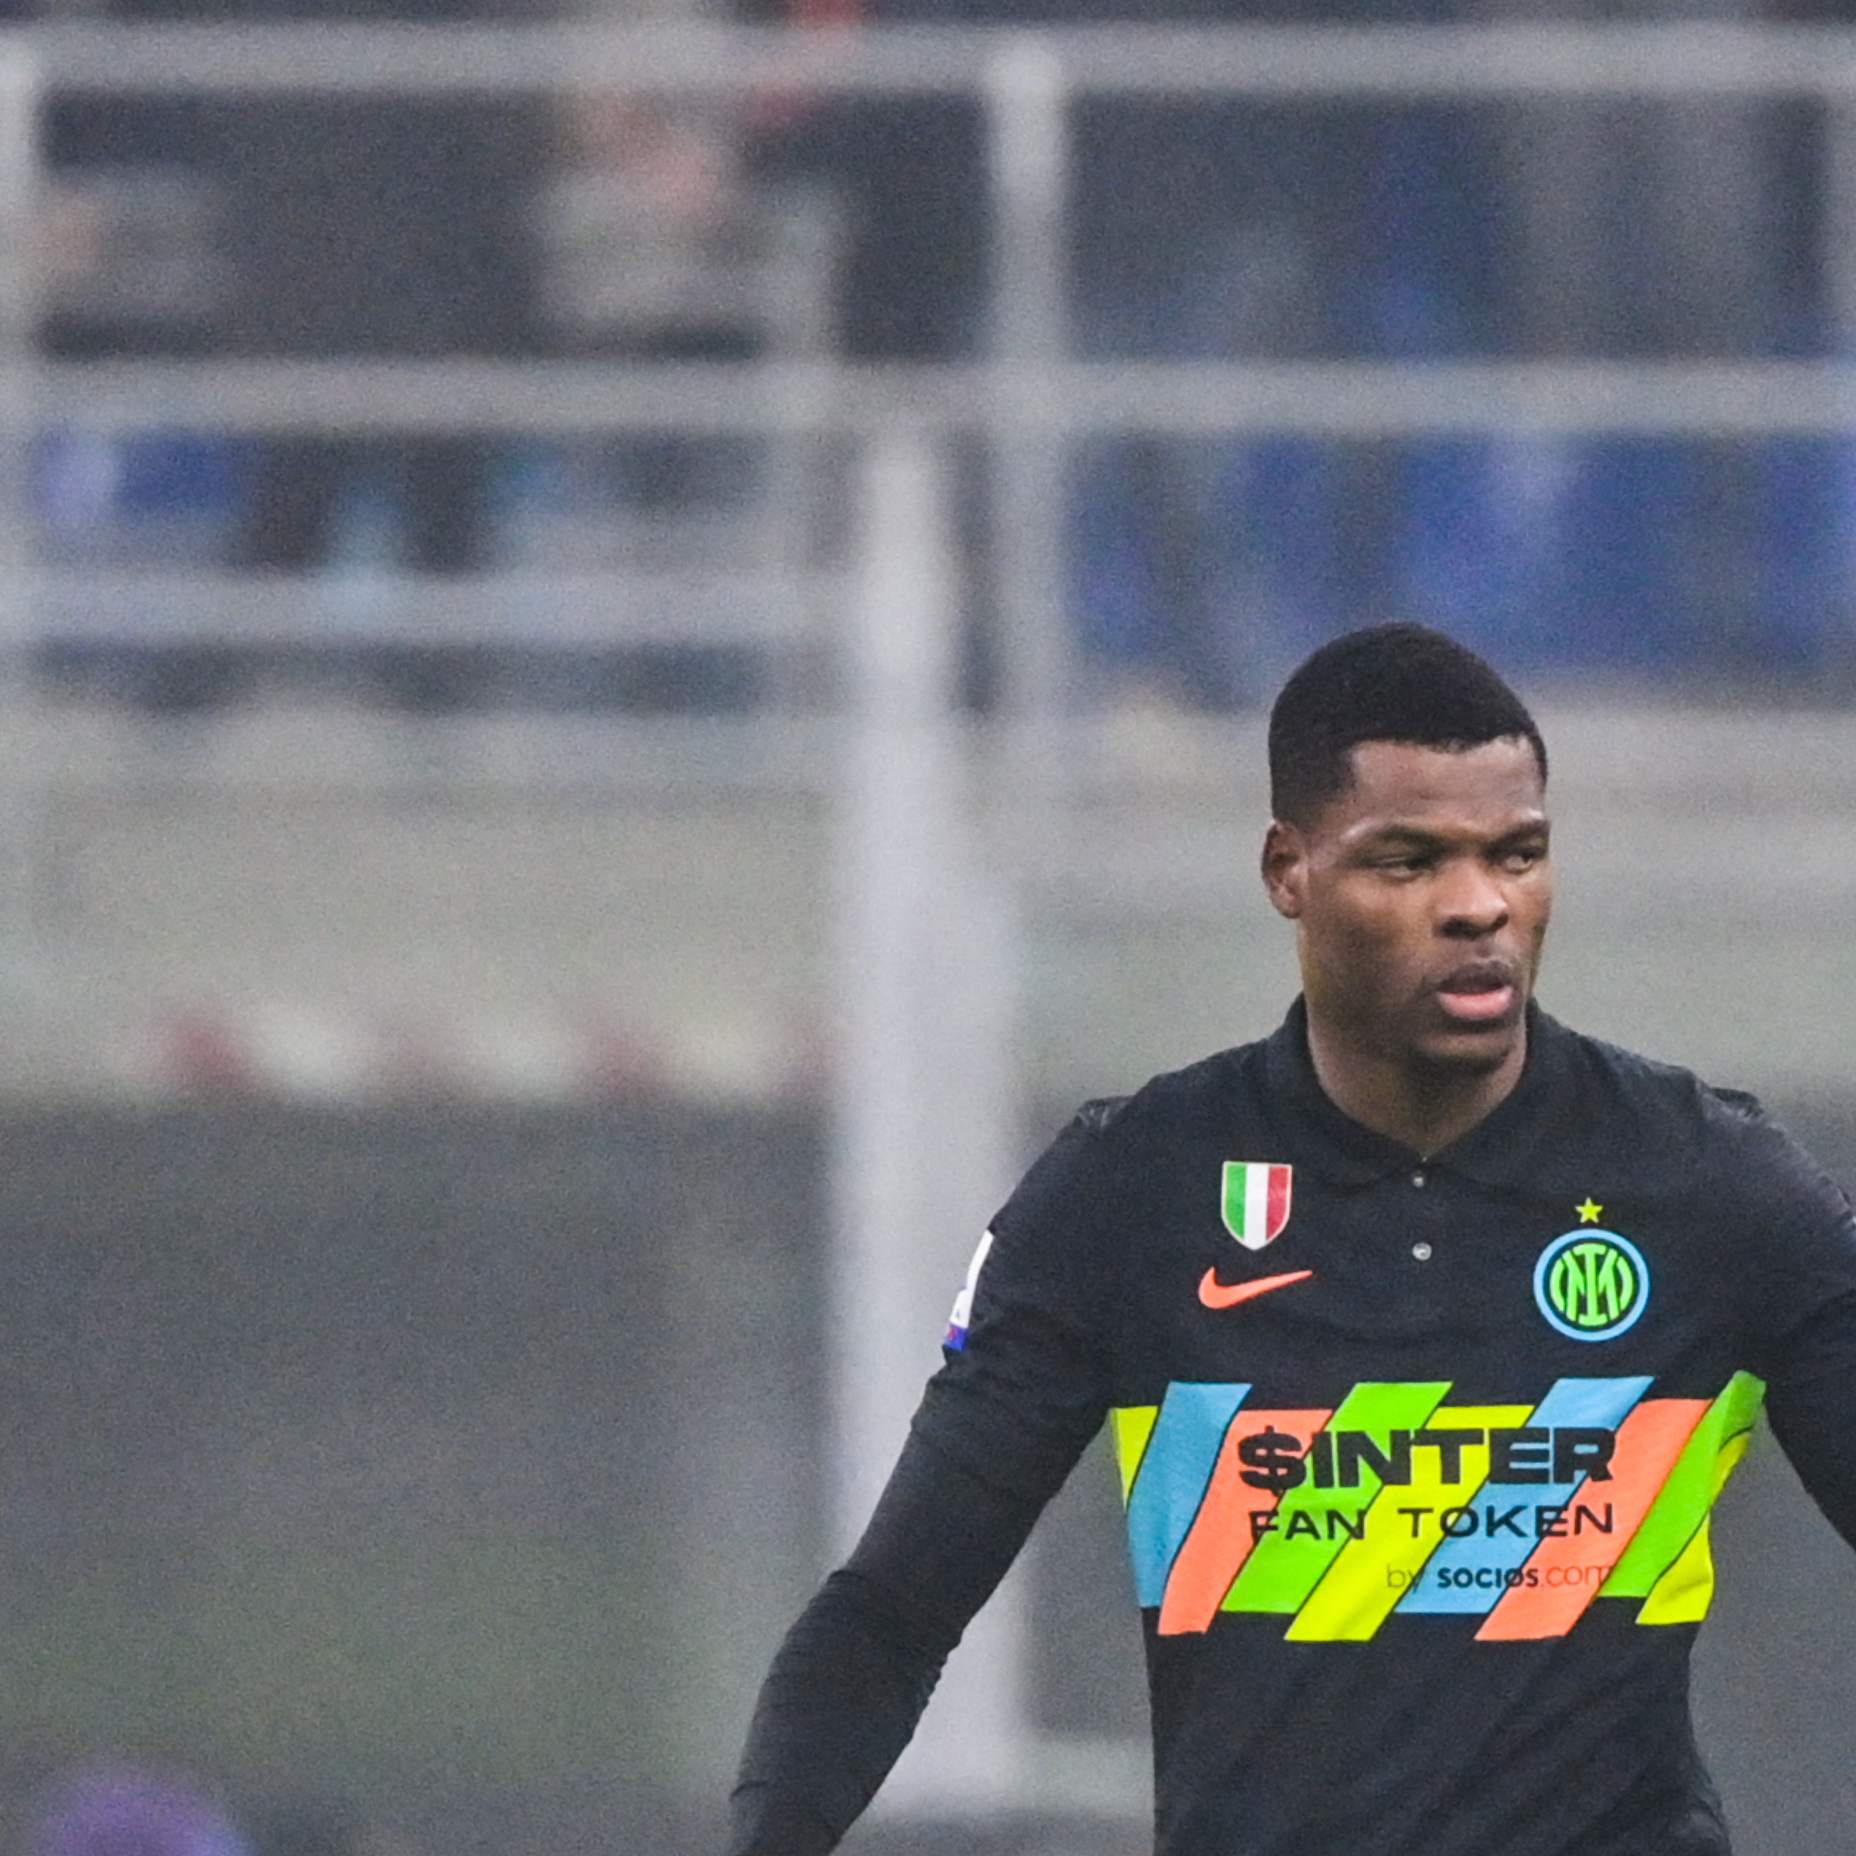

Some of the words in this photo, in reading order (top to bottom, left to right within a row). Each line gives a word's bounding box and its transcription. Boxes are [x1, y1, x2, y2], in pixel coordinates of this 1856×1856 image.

[1237, 1425, 1615, 1497] $INTER
[1249, 1508, 1366, 1542] FAN
[1397, 1503, 1614, 1539] TOKEN
[1385, 1563, 1426, 1594] by
